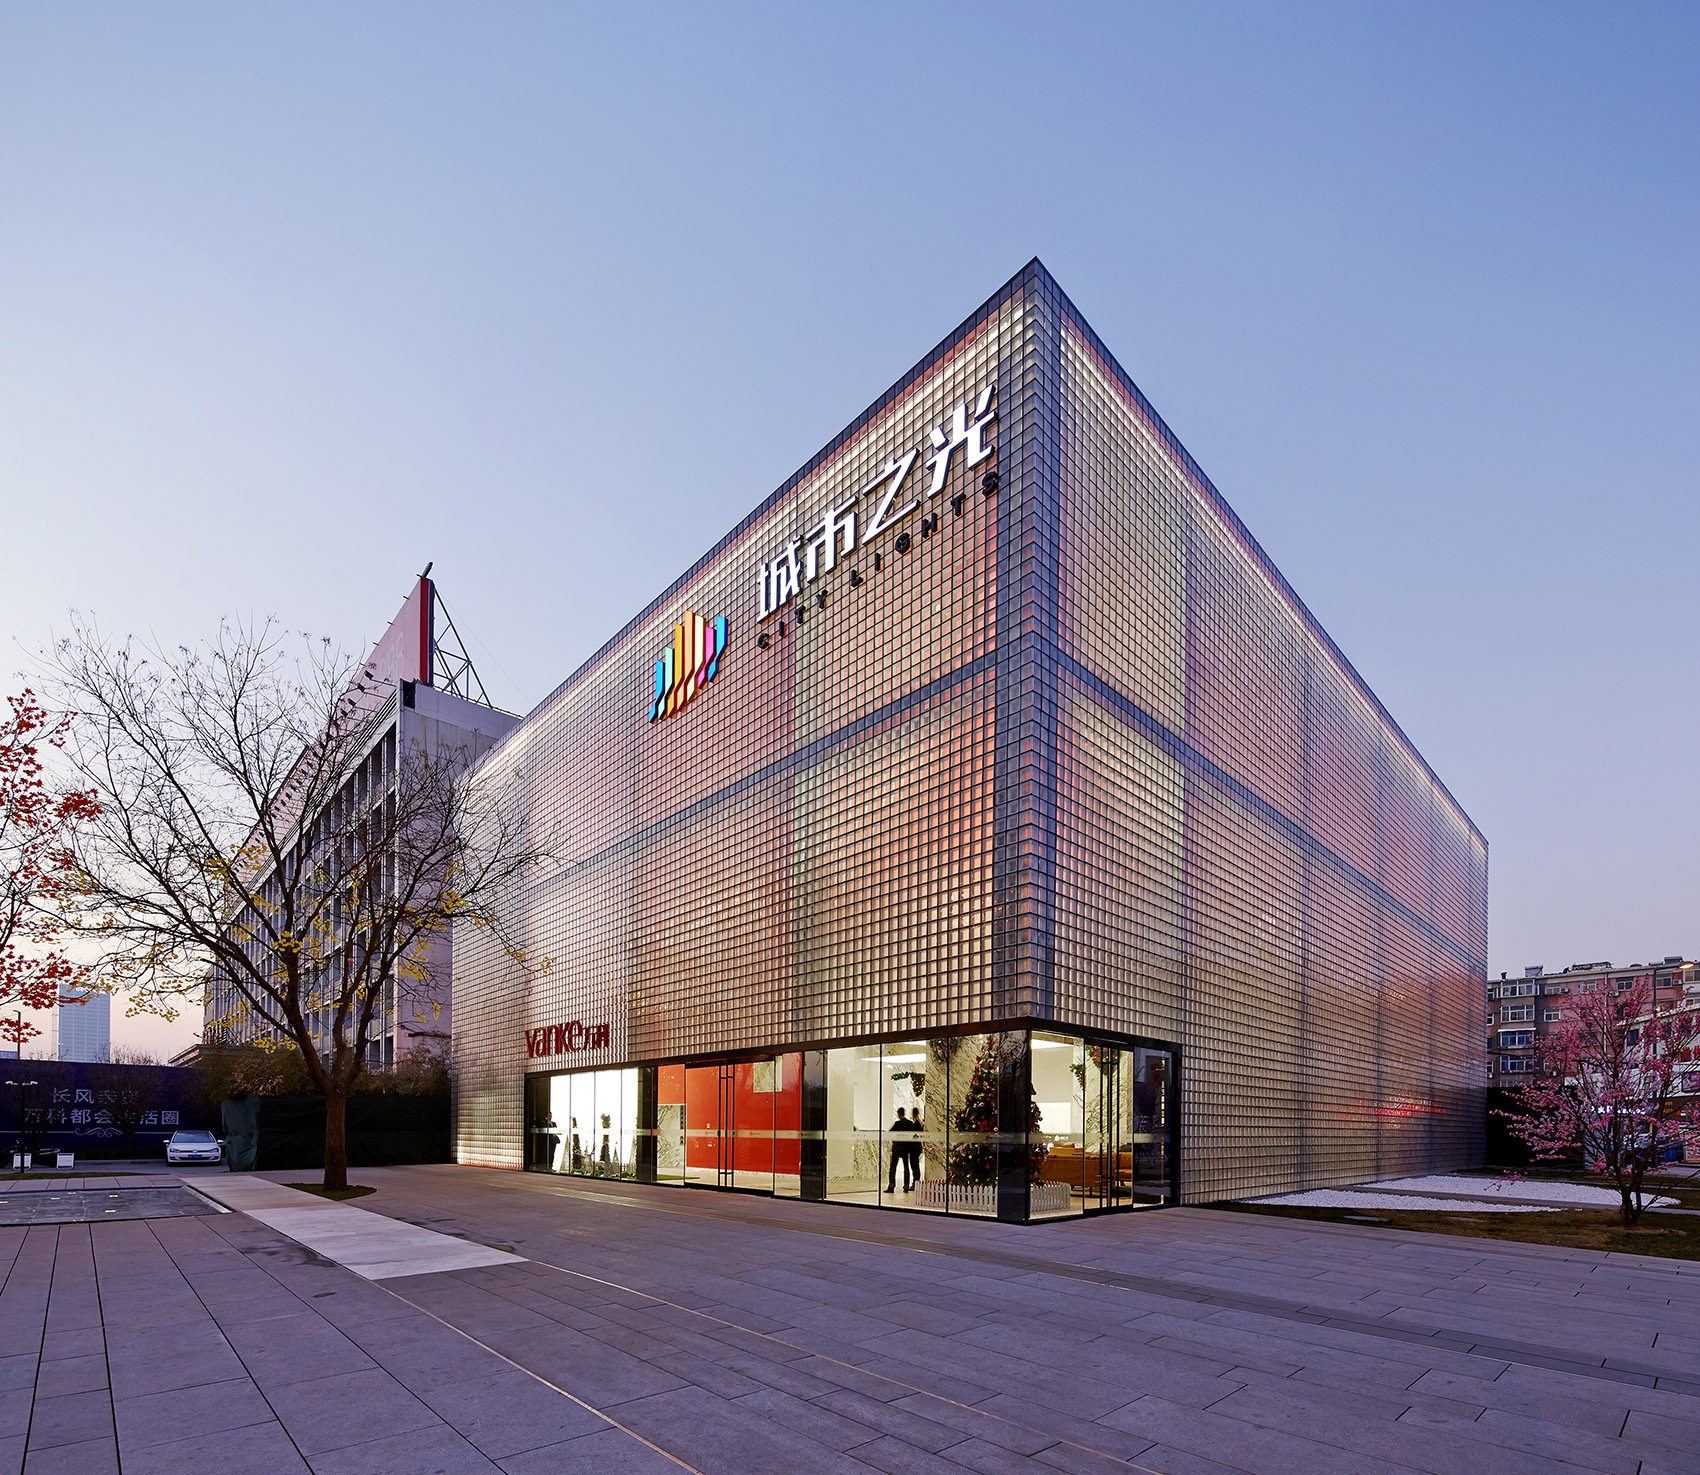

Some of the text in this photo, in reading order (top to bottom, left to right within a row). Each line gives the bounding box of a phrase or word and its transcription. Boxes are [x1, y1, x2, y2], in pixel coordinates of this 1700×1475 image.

[757, 384, 998, 624] 城市之光
[757, 471, 998, 650] CITY LIGHTS
